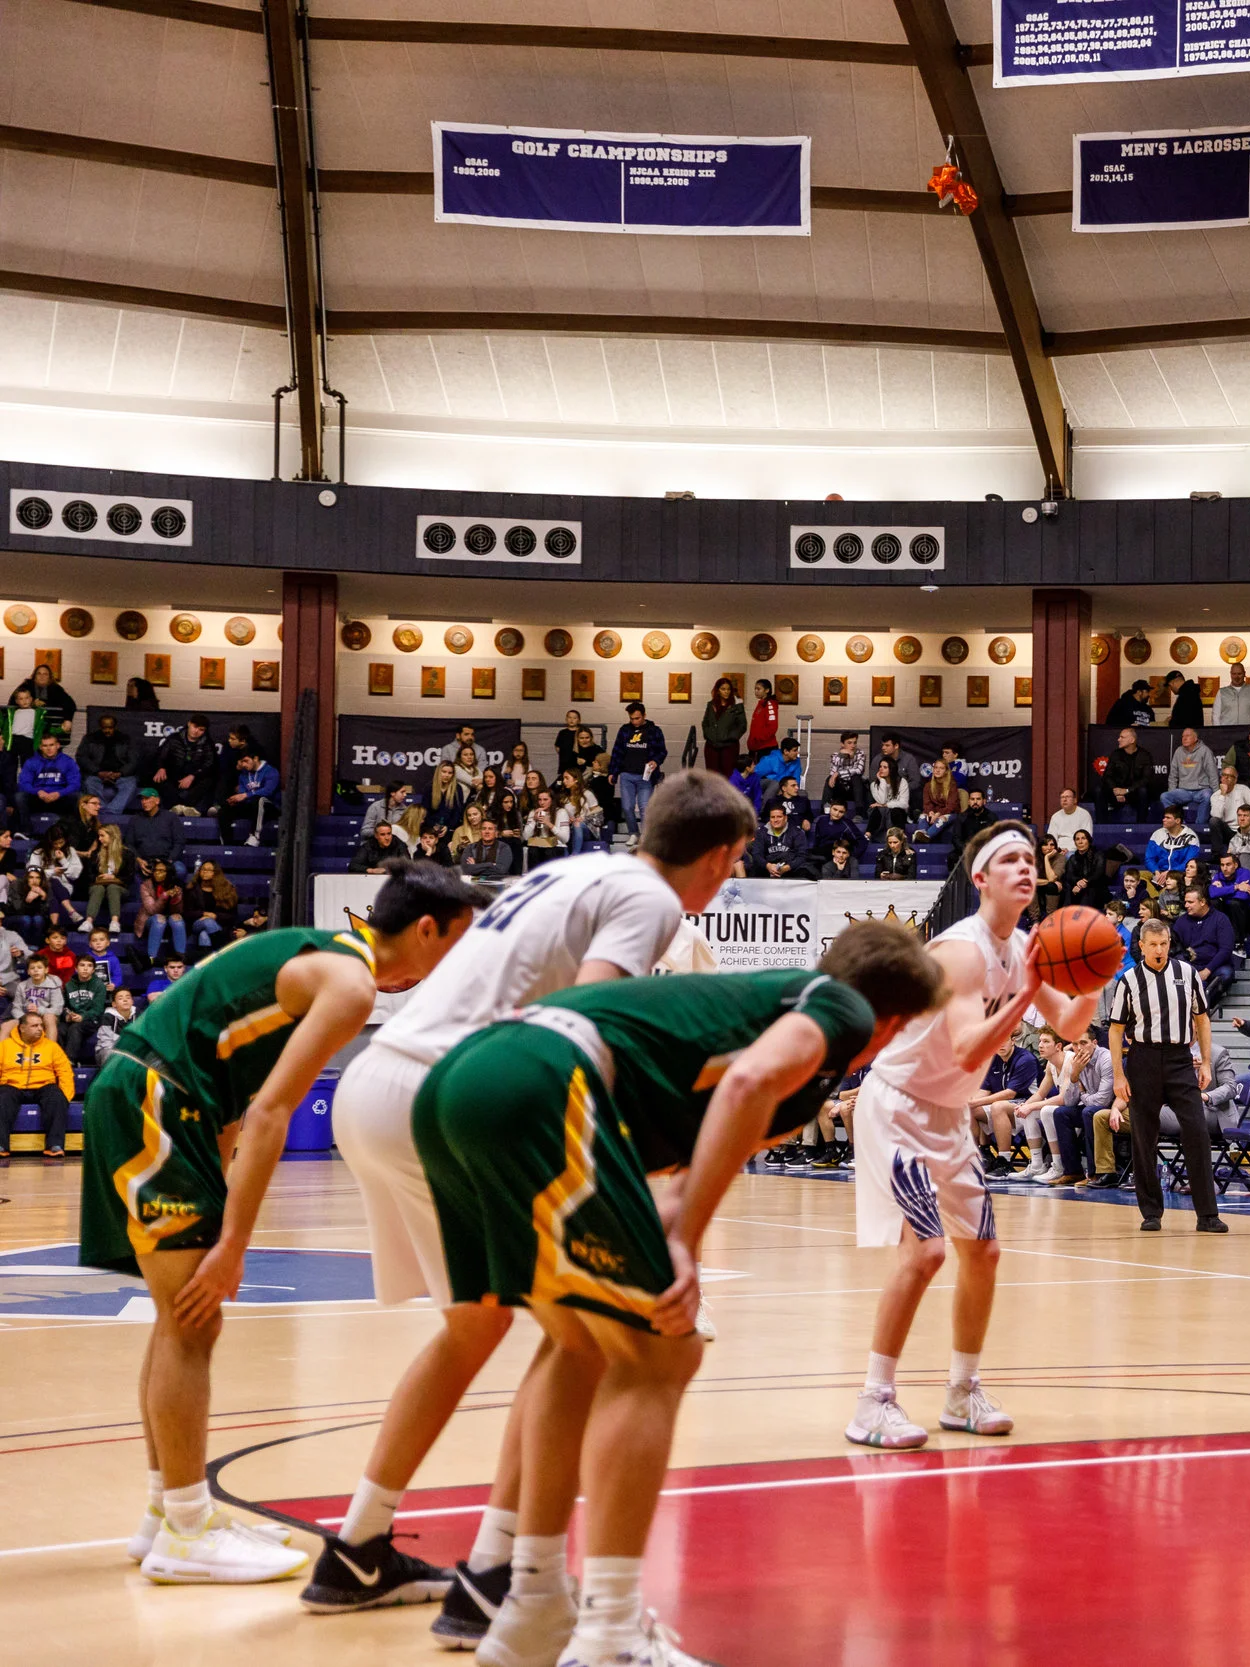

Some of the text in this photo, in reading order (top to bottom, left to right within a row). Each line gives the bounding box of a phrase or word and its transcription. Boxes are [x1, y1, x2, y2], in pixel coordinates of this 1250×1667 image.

[1186, 19, 1236, 32] 2006,07,09
[1184, 40, 1226, 52] DISTRICT
[512, 140, 728, 163] GOLF CHAMPIONSHIPS
[1121, 142, 1168, 157] MEN'S
[464, 158, 488, 167] GSAC
[629, 167, 716, 178] NJCAA REGION XIX
[1103, 164, 1125, 173] GSAC
[1090, 173, 1134, 183] 2013,14,15
[720, 946, 808, 955] PREPARE. COMPETE.
[720, 957, 807, 966] ACHIEVE. SUCCEED.
